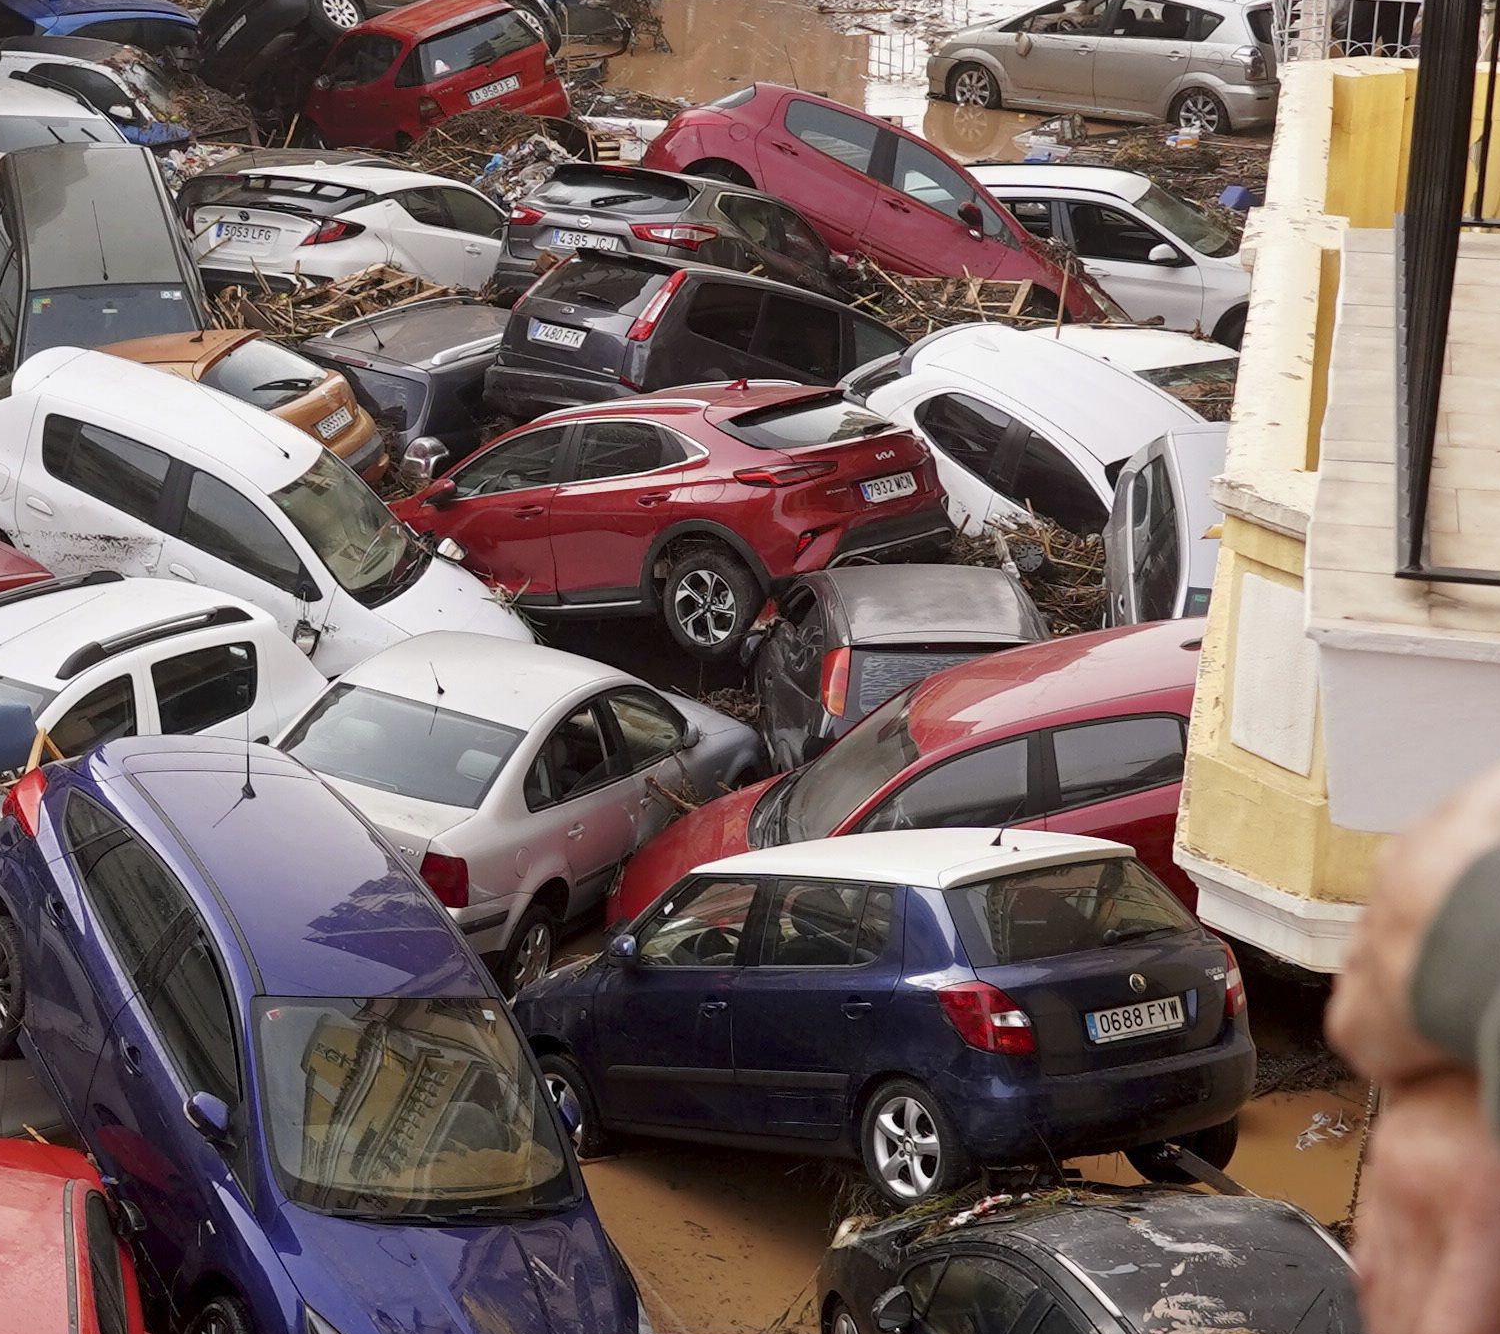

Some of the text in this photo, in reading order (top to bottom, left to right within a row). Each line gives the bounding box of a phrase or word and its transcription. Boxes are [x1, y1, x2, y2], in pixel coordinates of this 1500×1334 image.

[224, 225, 272, 241] 5053 LFG
[559, 232, 587, 246] 4385
[537, 325, 561, 342] 7480
[867, 480, 894, 498] 7932
[1098, 1000, 1180, 1034] 0688 FYW
